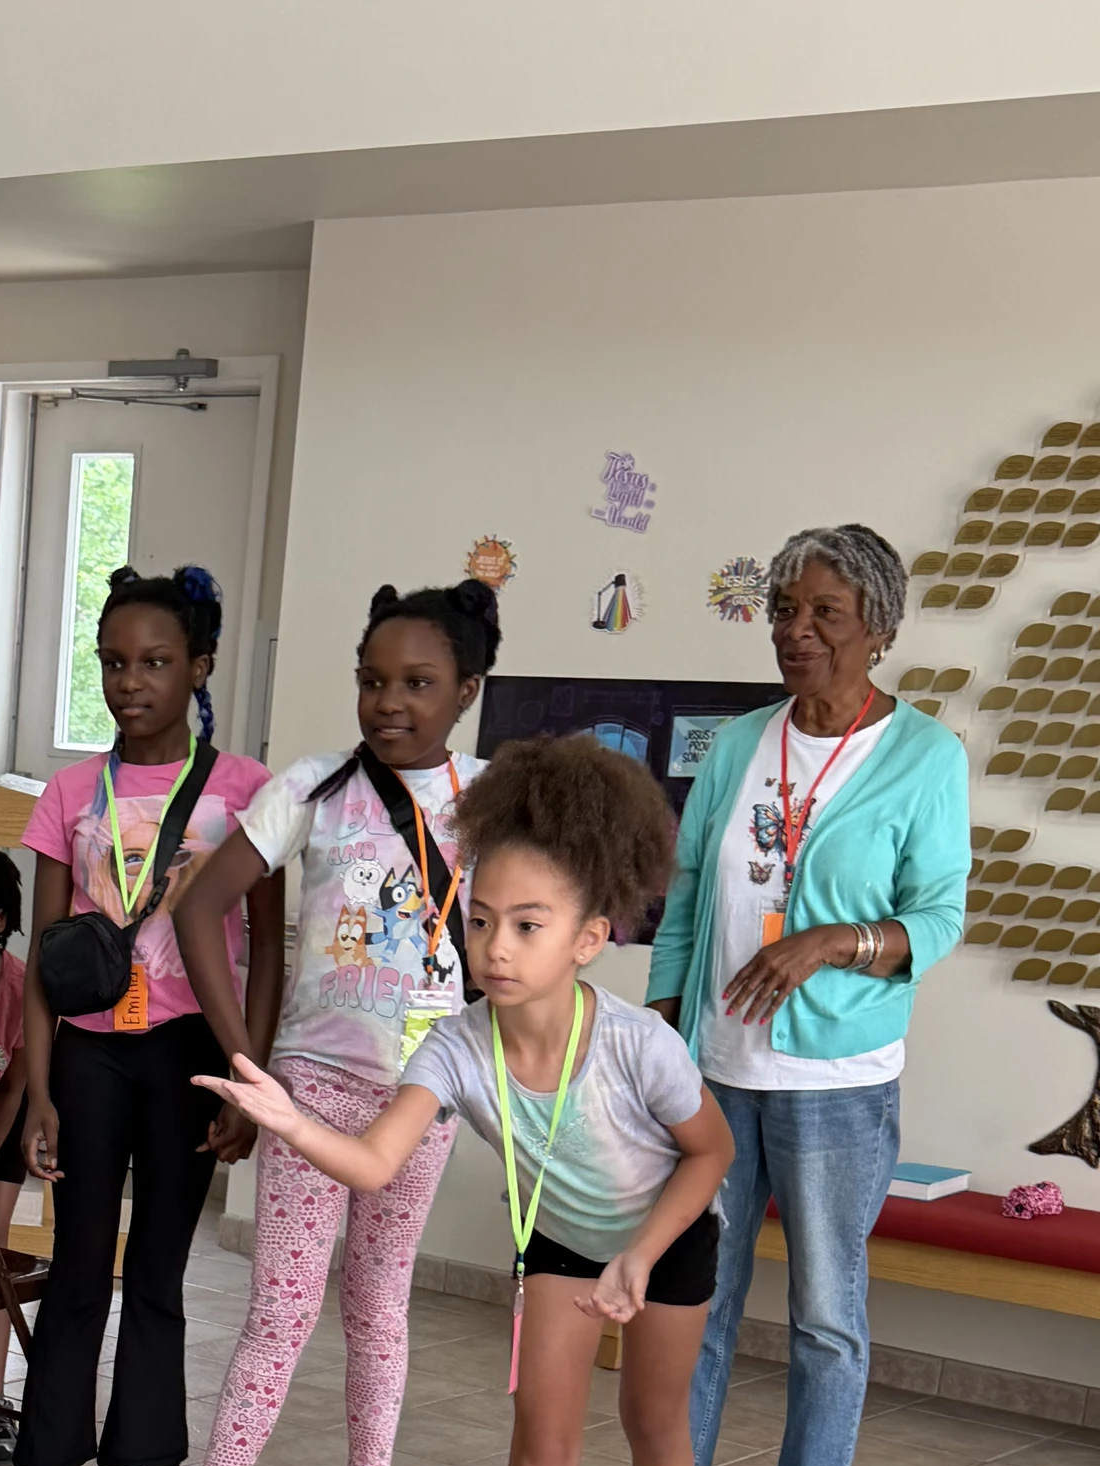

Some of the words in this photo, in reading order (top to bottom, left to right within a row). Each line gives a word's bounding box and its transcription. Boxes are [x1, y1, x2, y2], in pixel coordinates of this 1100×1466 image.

[603, 452, 648, 489] Jesus
[720, 575, 757, 588] JESUS
[684, 729, 711, 741] JESUS
[328, 841, 376, 866] AND
